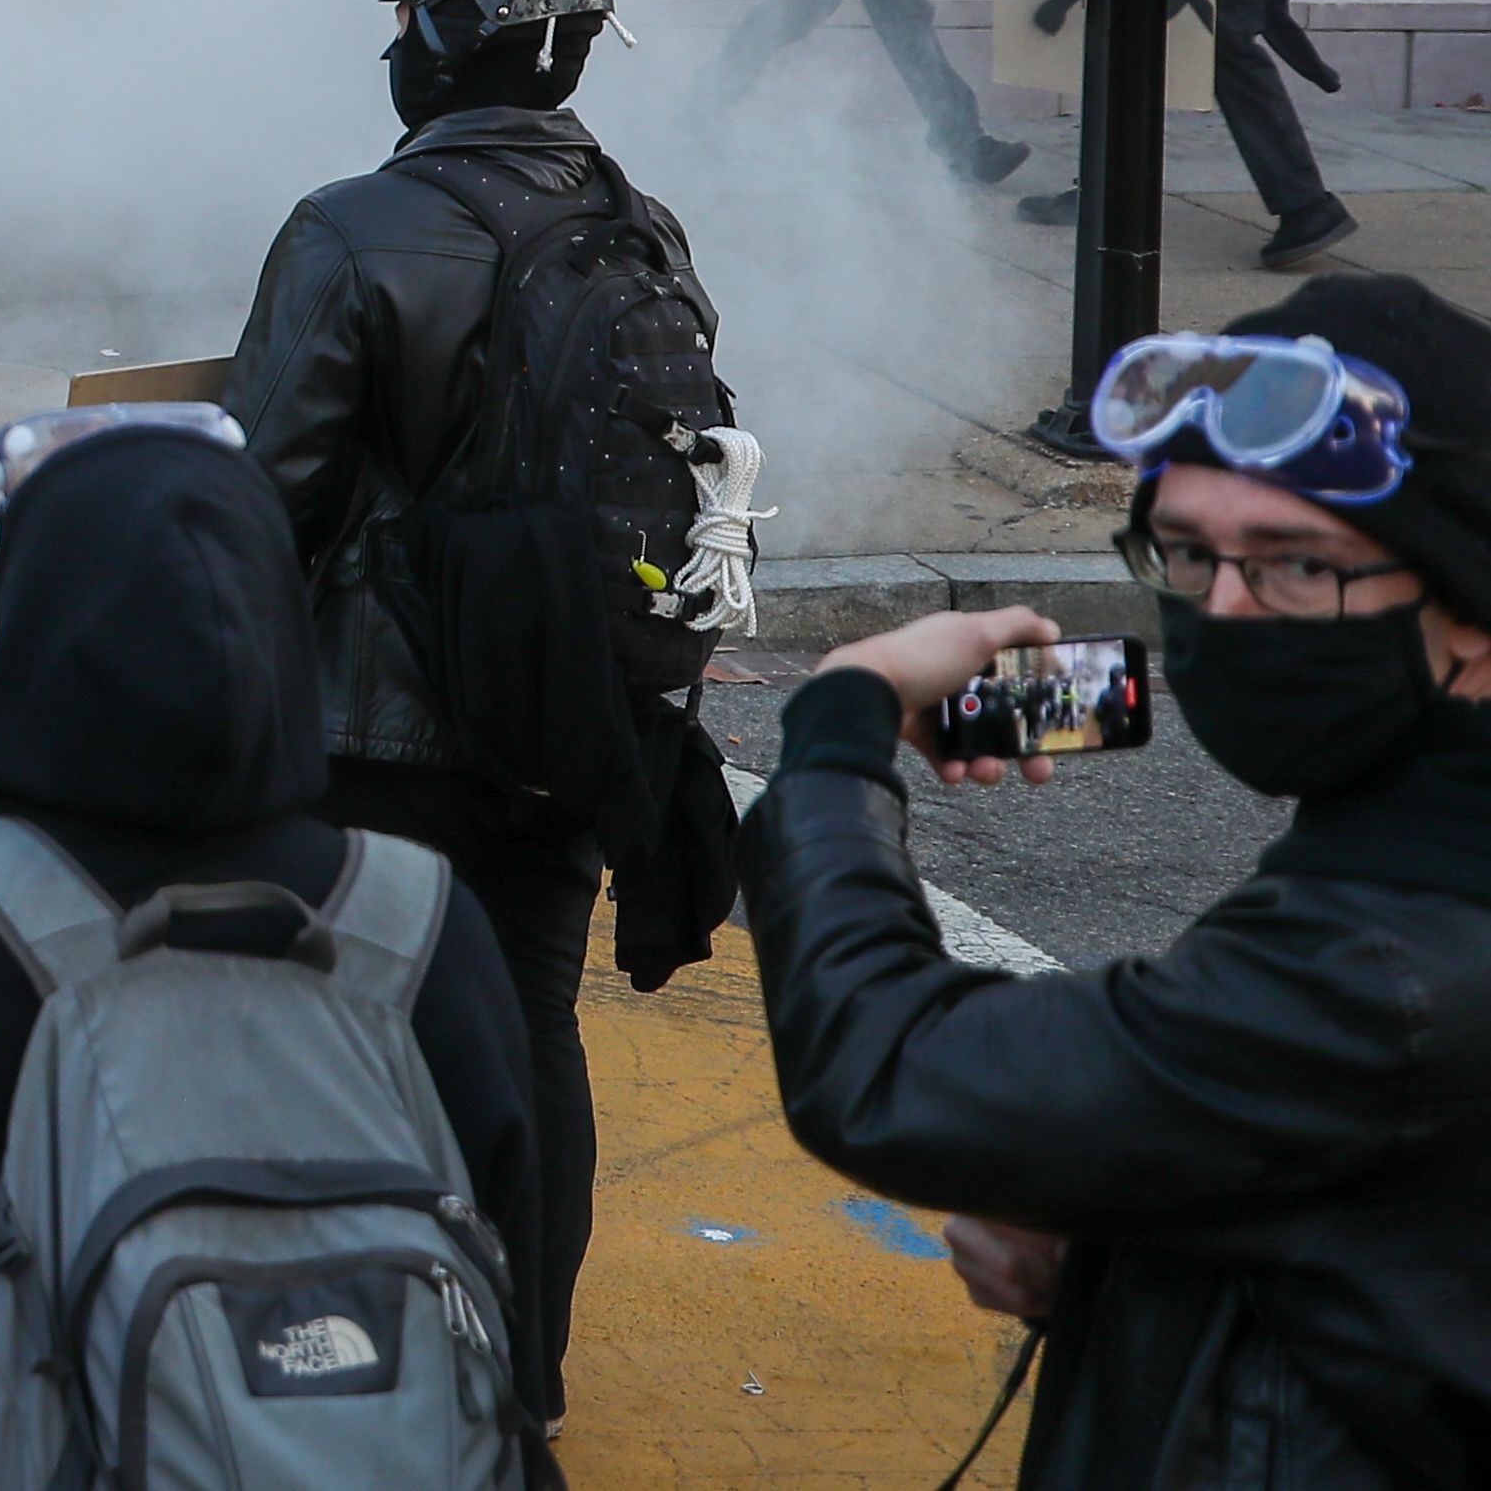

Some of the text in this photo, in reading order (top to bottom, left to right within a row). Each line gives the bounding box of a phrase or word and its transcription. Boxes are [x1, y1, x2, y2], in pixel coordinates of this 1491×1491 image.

[283, 1318, 326, 1342] THE
[258, 1332, 332, 1360] NORTH
[281, 1352, 338, 1376] FACE
